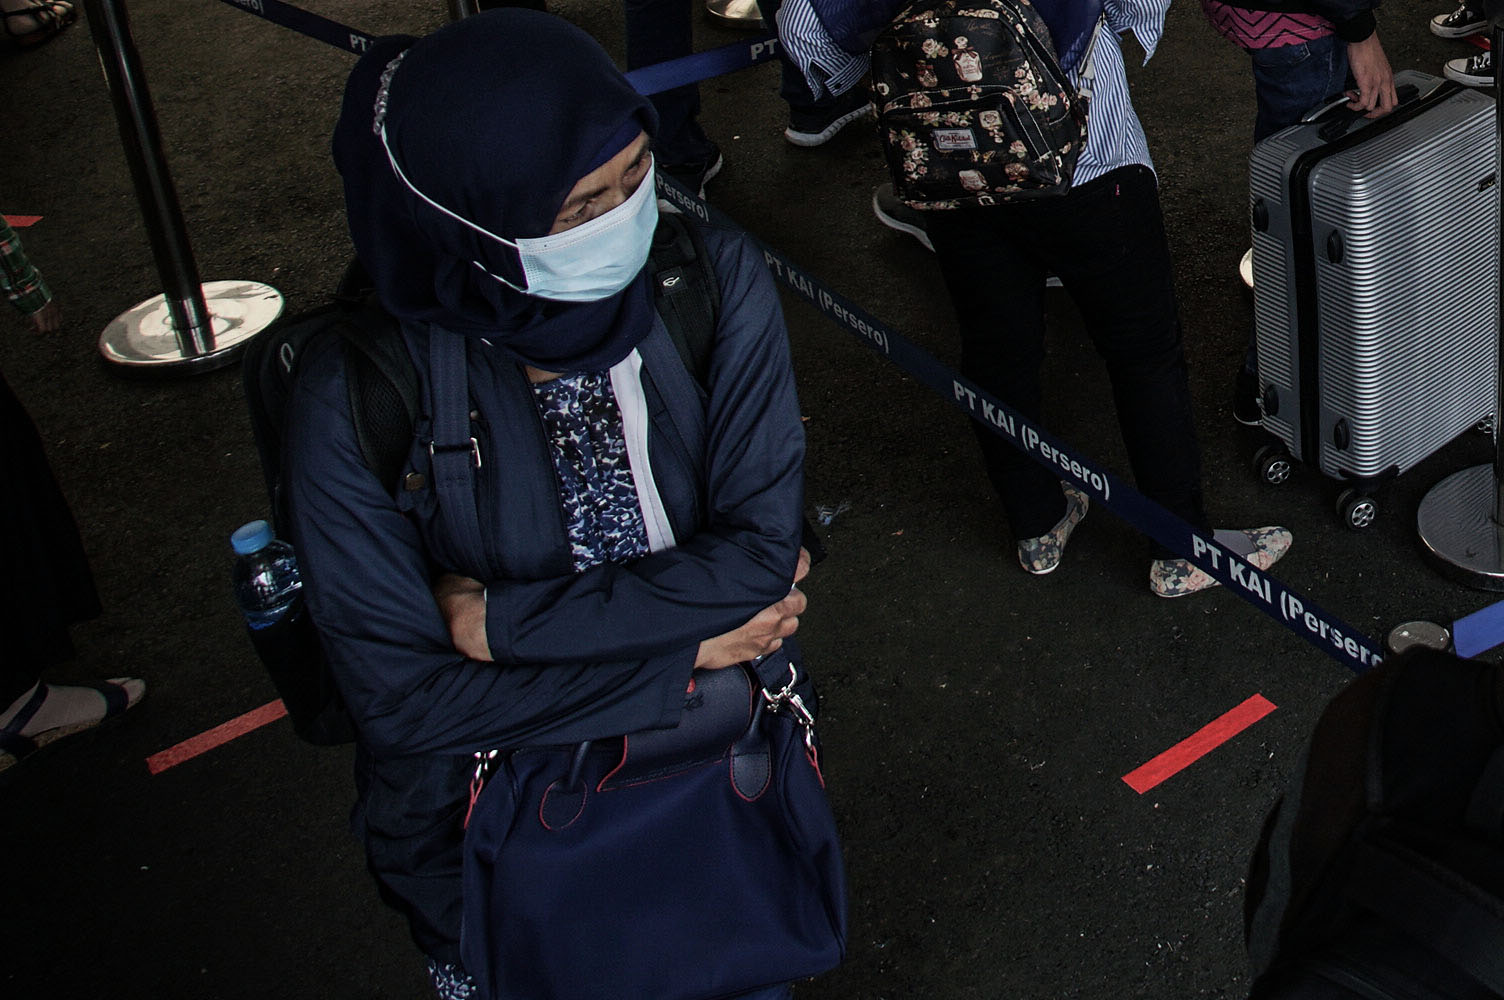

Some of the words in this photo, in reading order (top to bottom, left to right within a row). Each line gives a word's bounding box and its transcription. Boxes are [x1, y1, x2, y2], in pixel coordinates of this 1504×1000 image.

[349, 33, 367, 52] PT
[750, 38, 778, 60] PT
[656, 172, 710, 223] Persero)
[763, 249, 783, 277] PT
[786, 267, 815, 300] KAI
[818, 288, 890, 355] (Persero)
[953, 379, 977, 411] PT
[981, 398, 1016, 438] KAI
[1021, 423, 1110, 501] (Persero)
[1192, 533, 1222, 570] PT
[1228, 557, 1272, 604] KAI
[1280, 590, 1384, 668] (Perser
